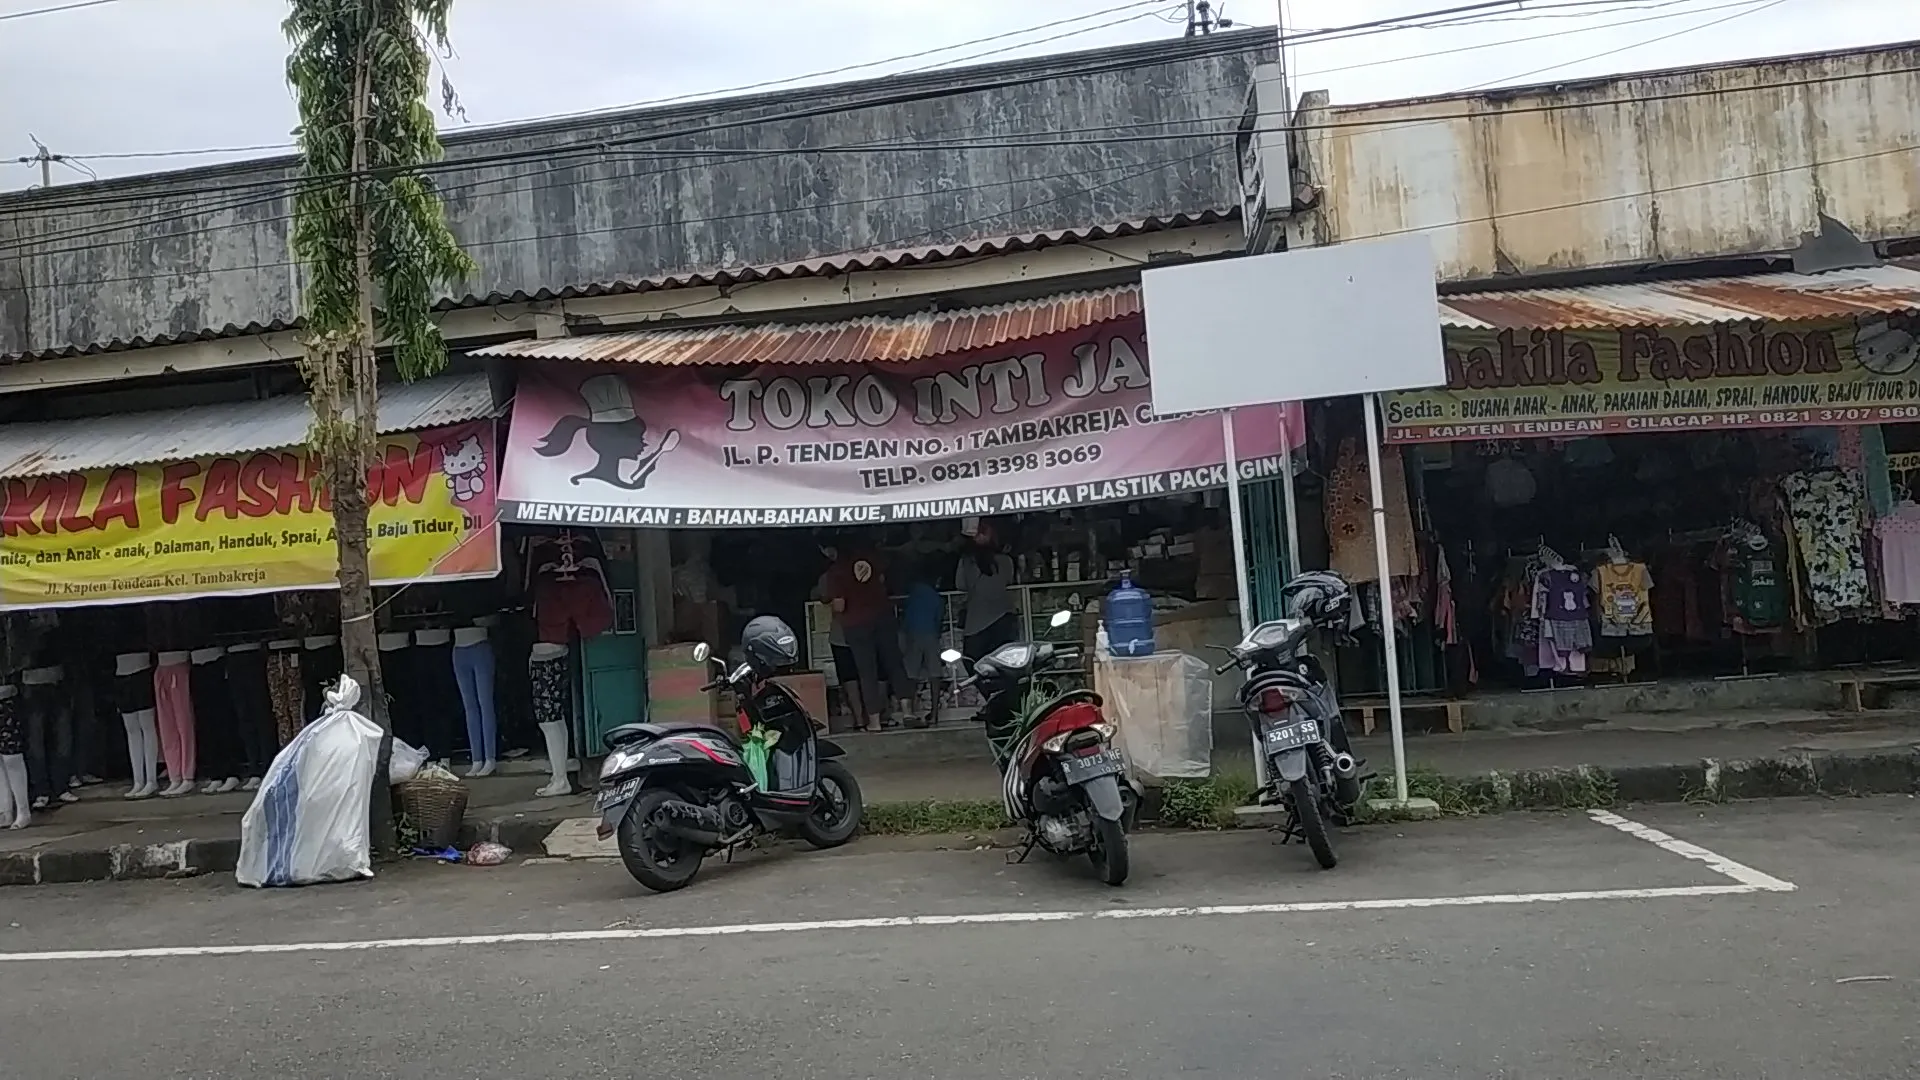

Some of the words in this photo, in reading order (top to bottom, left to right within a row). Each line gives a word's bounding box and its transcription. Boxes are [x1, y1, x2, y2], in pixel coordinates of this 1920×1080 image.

[1618, 320, 1842, 381] Fashion
[720, 373, 898, 431] TOKO
[912, 352, 1051, 425] INTI
[1063, 334, 1148, 398] JA
[1388, 400, 1444, 424] Sedia
[1461, 399, 1510, 419] BUSANA
[1513, 396, 1549, 416] ANAK
[1561, 393, 1600, 414] ANAK,
[1603, 390, 1659, 412] PAKAIAN
[1664, 388, 1711, 410] DALAM,
[1715, 386, 1757, 408] SPRAI,
[1762, 383, 1822, 406] HANDUK,
[1828, 381, 1862, 403] BAJU
[1867, 381, 1904, 400] TIDUR
[1908, 380, 1920, 399] D
[723, 446, 752, 468] JL.
[757, 445, 779, 465] P.
[786, 440, 899, 464] TENDEAN
[905, 438, 949, 457] NO.
[955, 436, 964, 452] 1
[970, 409, 1129, 450] TAMBAKREJA
[1393, 428, 1422, 439] JL.
[1428, 423, 1504, 438] KAPTEN
[1512, 419, 1603, 434] TENDEAN
[1626, 415, 1714, 428] CILACAP
[1722, 412, 1751, 425] HP.
[1760, 410, 1810, 423] 0821
[1820, 408, 1871, 420] 3707
[1879, 406, 1920, 418] 960
[859, 467, 926, 489] TELP.
[931, 463, 981, 483] 0821
[987, 454, 1039, 476] 3398
[1045, 444, 1102, 467] 3069
[0, 466, 140, 537] KILA
[516, 502, 669, 524] MENYEDIAKAN
[686, 507, 833, 525] BAHAN-BAHAN
[838, 505, 887, 524] KUE,
[892, 496, 994, 520] MINUMAN,
[1000, 487, 1071, 512] ANEKA
[1077, 474, 1165, 501] PLASTIK
[36, 550, 61, 563] dan
[66, 547, 101, 562] Anak
[114, 543, 150, 560] anak,
[154, 539, 214, 556] Dalaman,
[219, 529, 277, 550] Handuk,
[281, 528, 321, 547] Sprai,
[377, 521, 408, 538] Baju
[413, 518, 458, 535] Tidur,
[64, 580, 107, 597] Kapten
[111, 575, 161, 591] Tendean
[163, 573, 187, 588] Kel.
[191, 568, 266, 586] Tambakreja
[1269, 728, 1294, 742] 5201
[1301, 722, 1315, 733] SS
[1077, 754, 1103, 768] 3073
